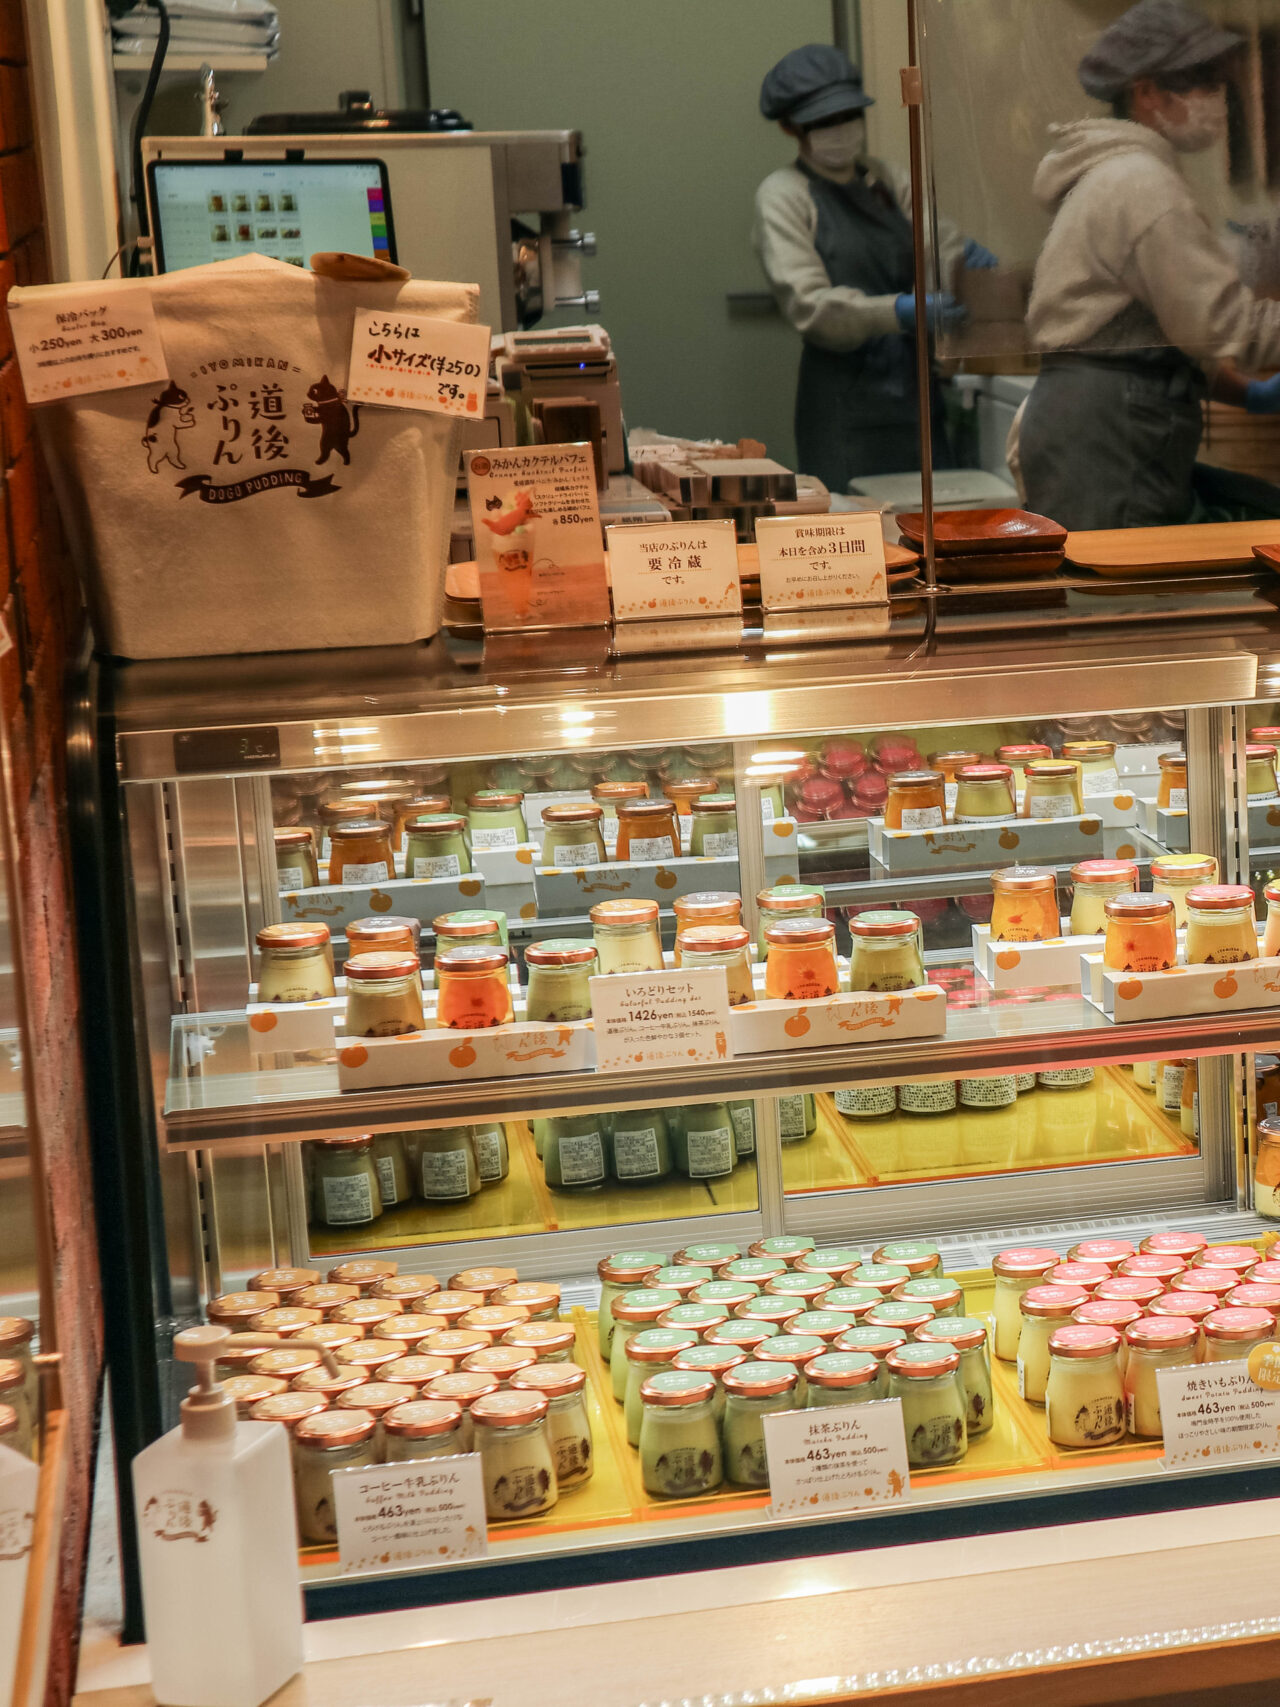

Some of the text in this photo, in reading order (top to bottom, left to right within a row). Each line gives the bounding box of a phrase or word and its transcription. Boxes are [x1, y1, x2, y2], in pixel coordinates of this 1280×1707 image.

[55, 305, 108, 325] 保冷バッグ
[368, 320, 421, 339] こちらは
[40, 337, 83, 351] 250yen
[101, 326, 143, 341] 300yen
[200, 357, 289, 375] IYOMIKAN
[437, 382, 465, 400] です。
[207, 383, 244, 465] ぷりん
[247, 382, 290, 461] 道後
[492, 453, 587, 470] みかんカクテルパフェ
[208, 472, 302, 501] DOGO PUDDING
[560, 513, 594, 525] 850yen
[794, 526, 846, 539] 賞味期限は
[639, 539, 708, 553] 当店のぷりんは
[779, 539, 866, 558] 本日を含め3日間
[648, 554, 702, 571] 要冷蔵
[809, 560, 832, 571] です。
[661, 575, 686, 585] です。
[625, 983, 694, 998] いろどりセット
[628, 1009, 674, 1022] 1426yen
[1186, 1375, 1255, 1392] 焼きいもぷりん
[1197, 1402, 1236, 1416] 463yen
[808, 1419, 861, 1437] 抹茶ぷりん
[806, 1447, 847, 1461] 463yen
[359, 1472, 460, 1494] コーヒー牛乳ぷりん
